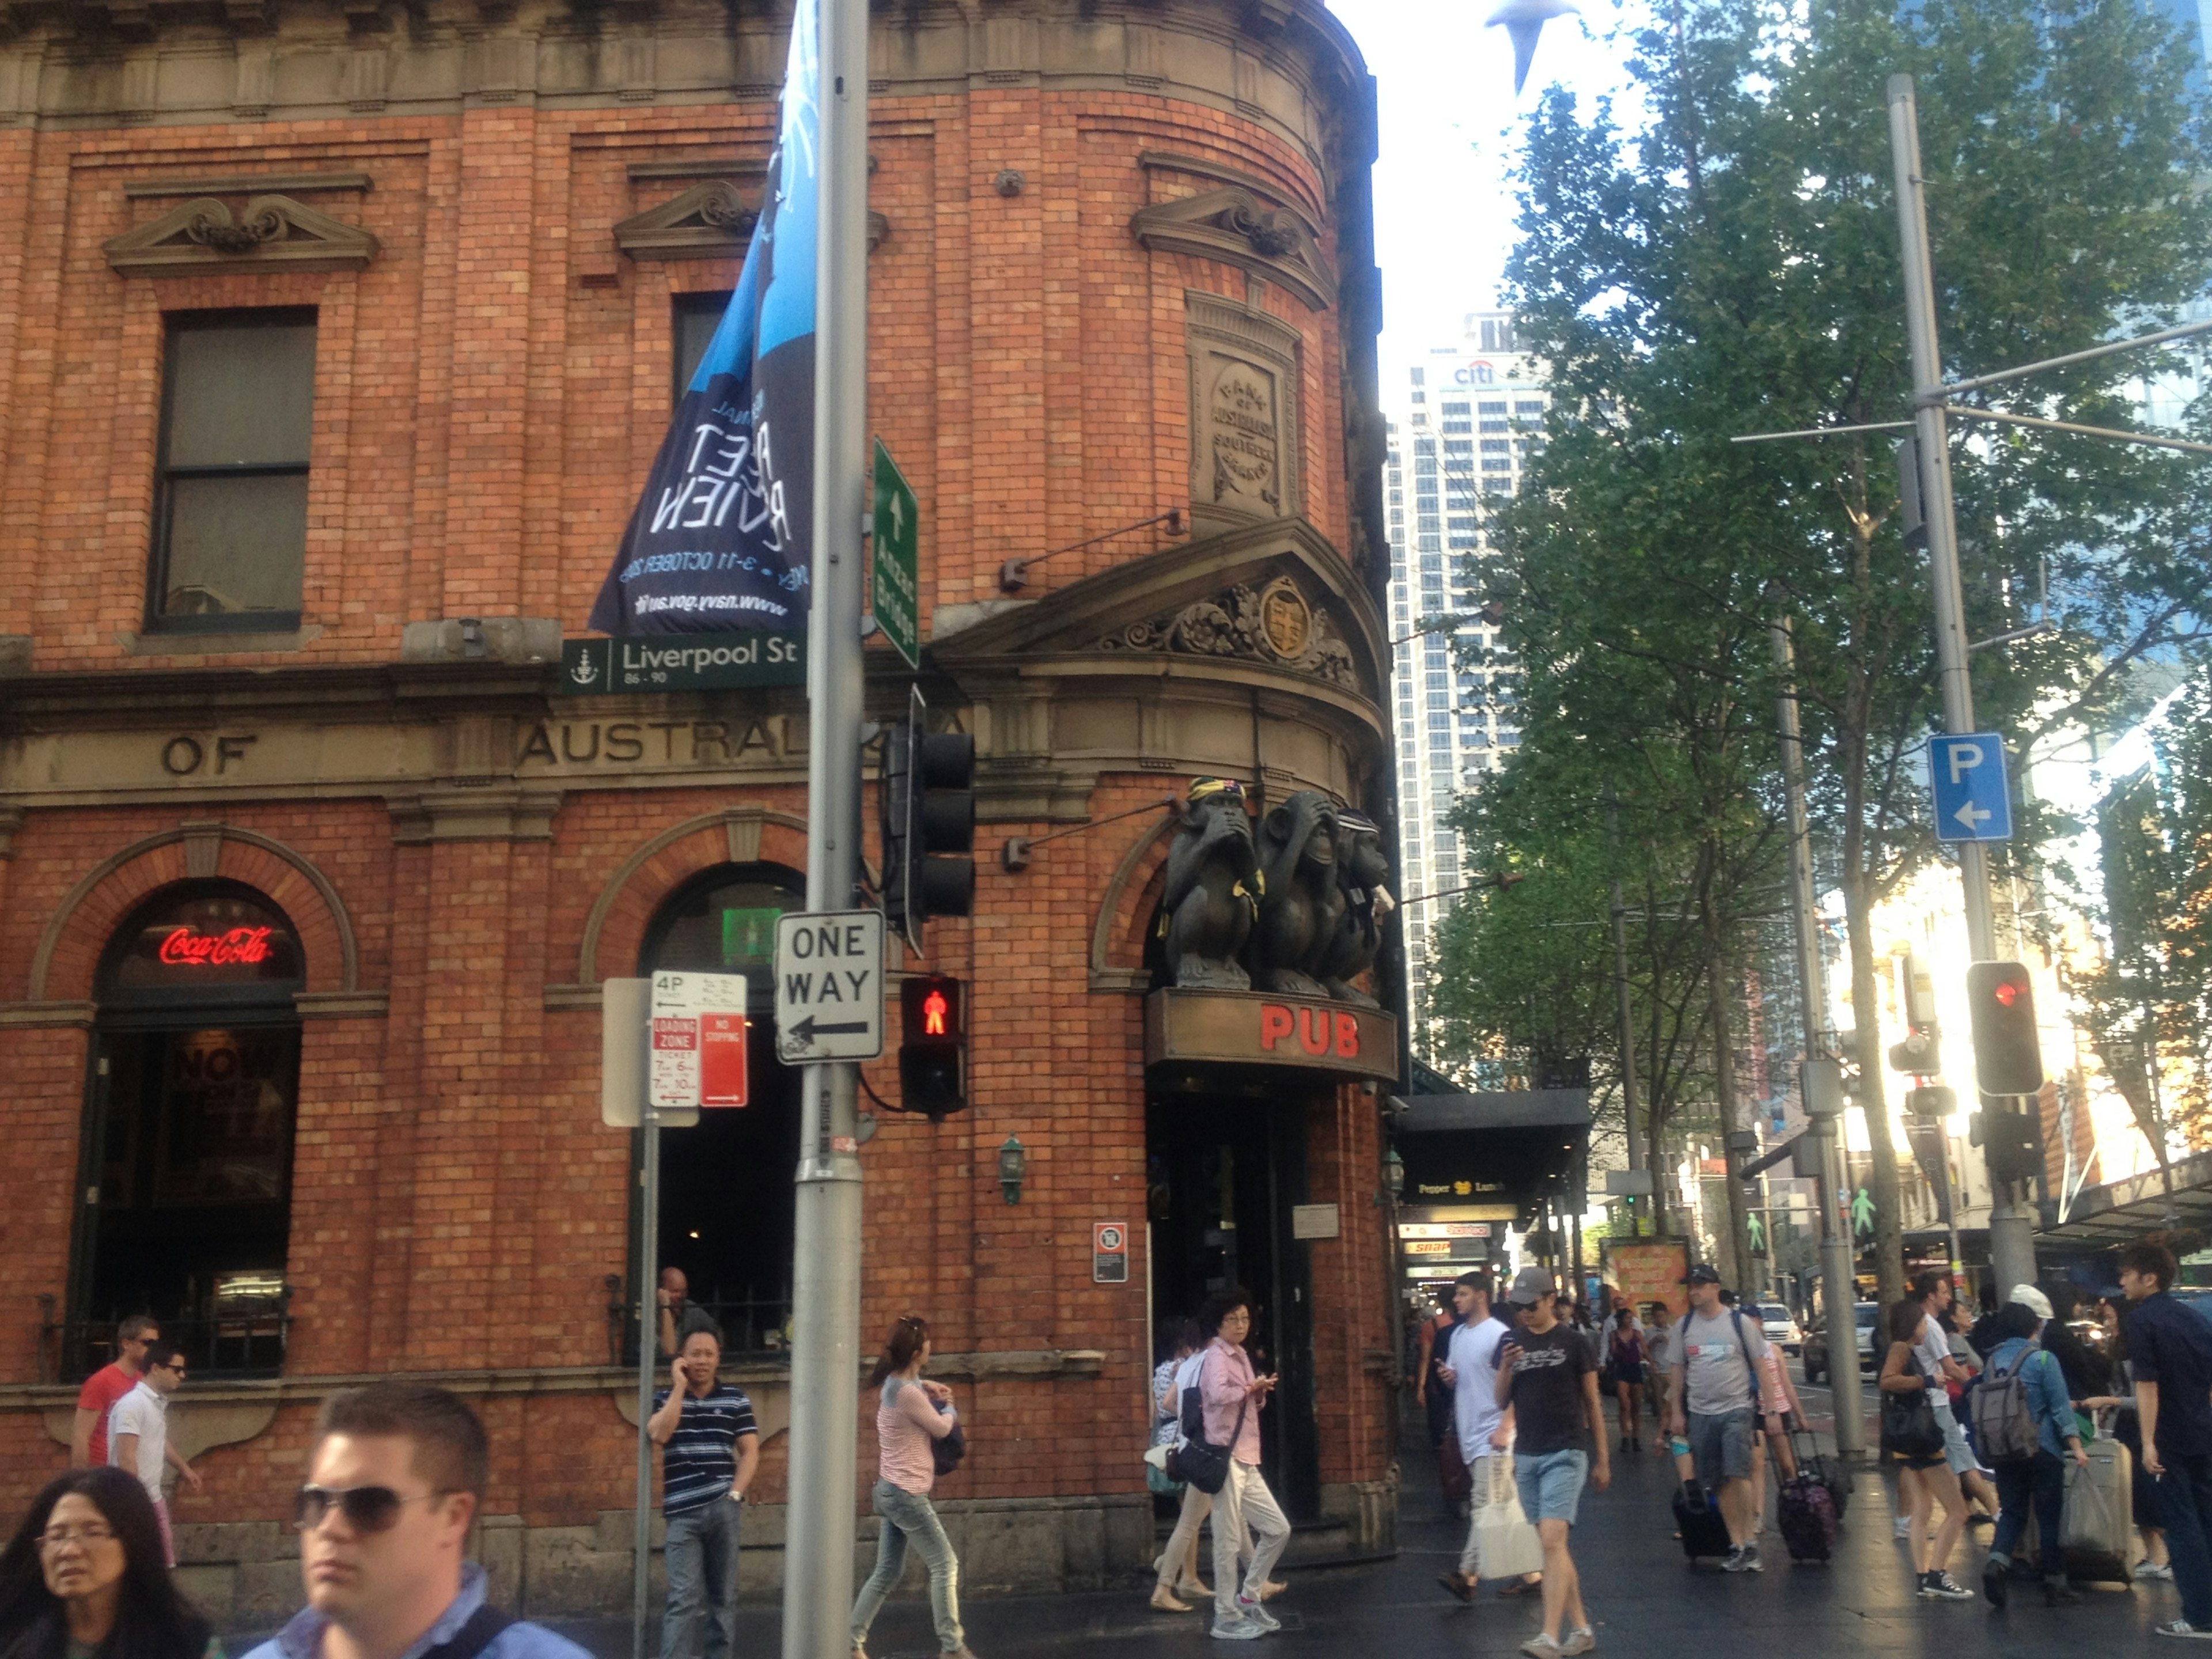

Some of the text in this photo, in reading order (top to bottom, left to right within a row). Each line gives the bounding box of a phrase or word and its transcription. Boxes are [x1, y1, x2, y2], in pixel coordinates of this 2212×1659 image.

[1455, 365, 1493, 384] citi
[876, 573, 914, 646] Bridge
[623, 637, 798, 674] Liverpool St
[624, 672, 640, 684] 86
[650, 672, 667, 683] 90
[162, 734, 257, 777] OF
[1948, 743, 1984, 783] P
[160, 926, 274, 965] Coca-Cola
[793, 925, 865, 959] ONE
[786, 970, 870, 1005] WAY
[660, 1035, 691, 1048] ZONE
[1260, 1002, 1361, 1059] PUB
